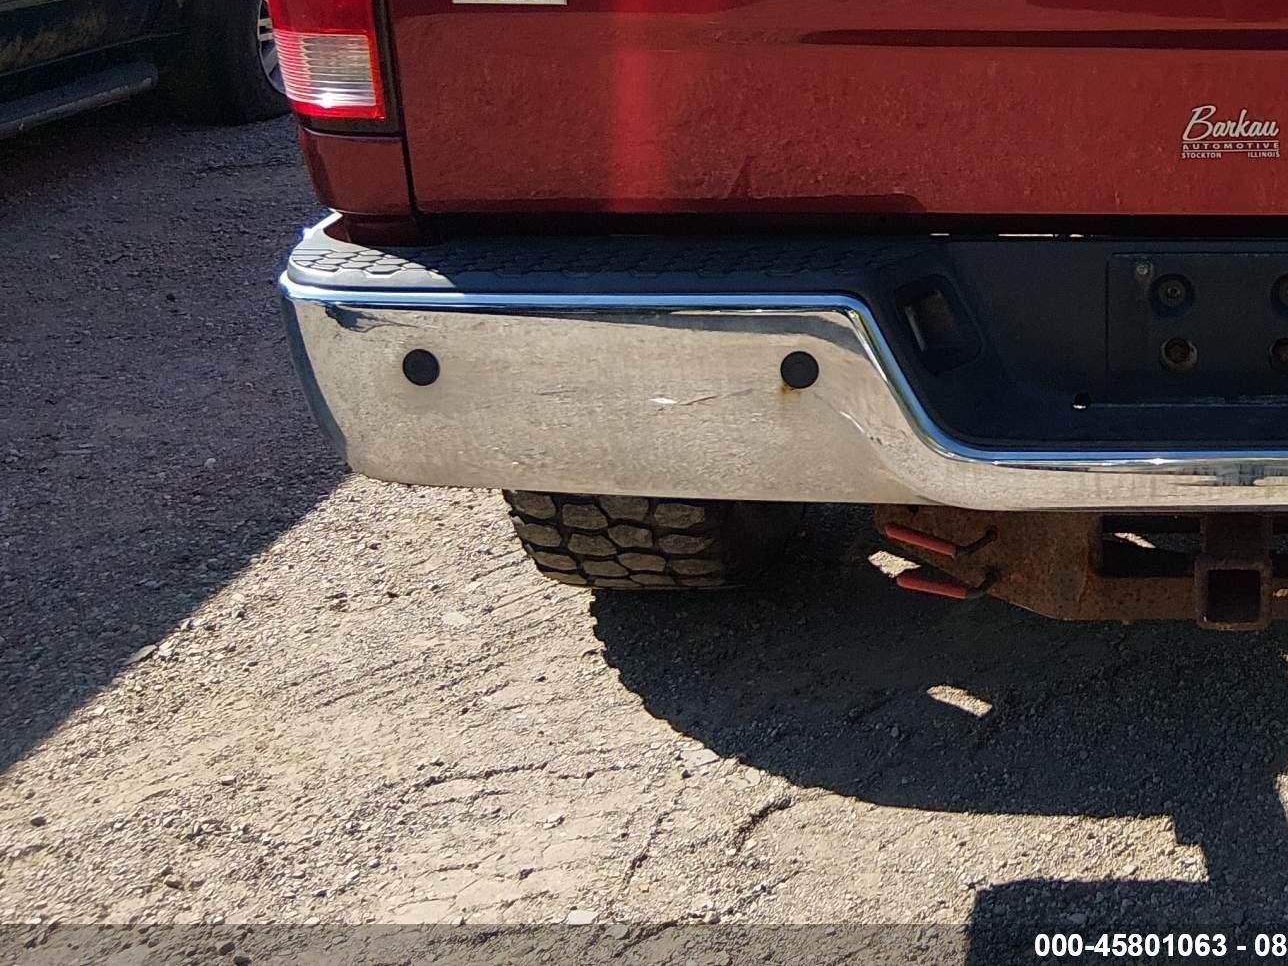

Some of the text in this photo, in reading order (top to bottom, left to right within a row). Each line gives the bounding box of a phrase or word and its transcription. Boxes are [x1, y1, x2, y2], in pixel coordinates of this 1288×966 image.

[1182, 105, 1280, 141] Barkau
[1182, 142, 1280, 150] AUTOMOTIVE
[1181, 150, 1281, 159] STOCKTON ILLINOIS
